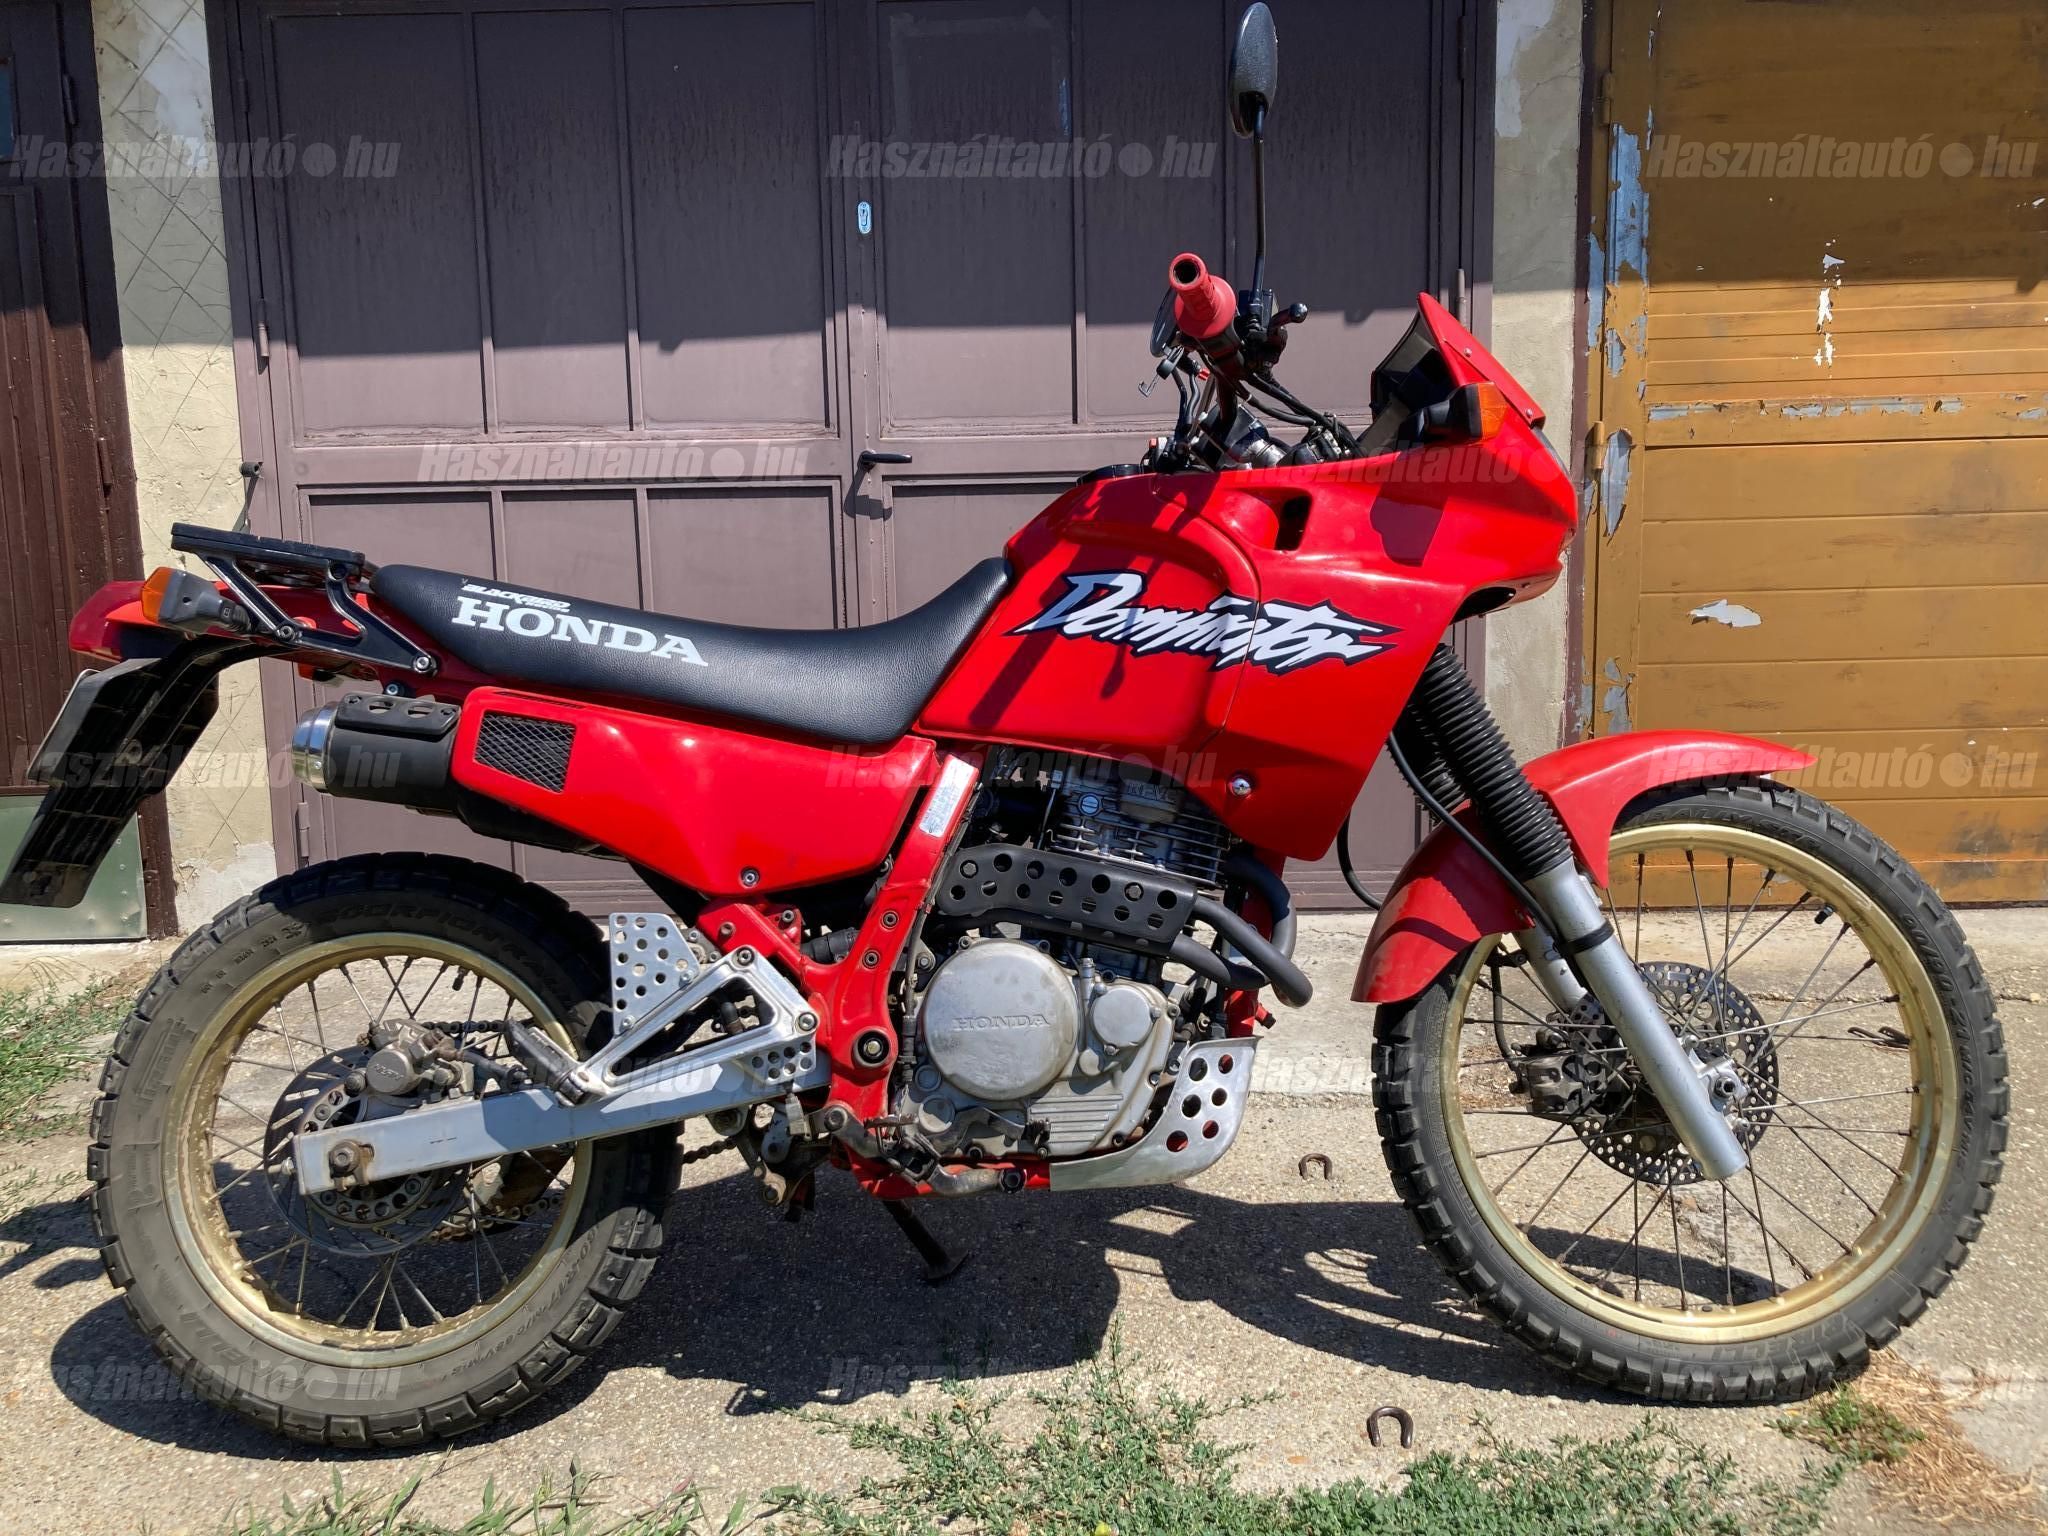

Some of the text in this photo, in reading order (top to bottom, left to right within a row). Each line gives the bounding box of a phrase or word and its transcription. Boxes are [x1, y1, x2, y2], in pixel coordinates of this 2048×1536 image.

[451, 595, 710, 667] HONDA
[1005, 570, 1396, 674] Dominator
[951, 1013, 1051, 1032] HONDA
